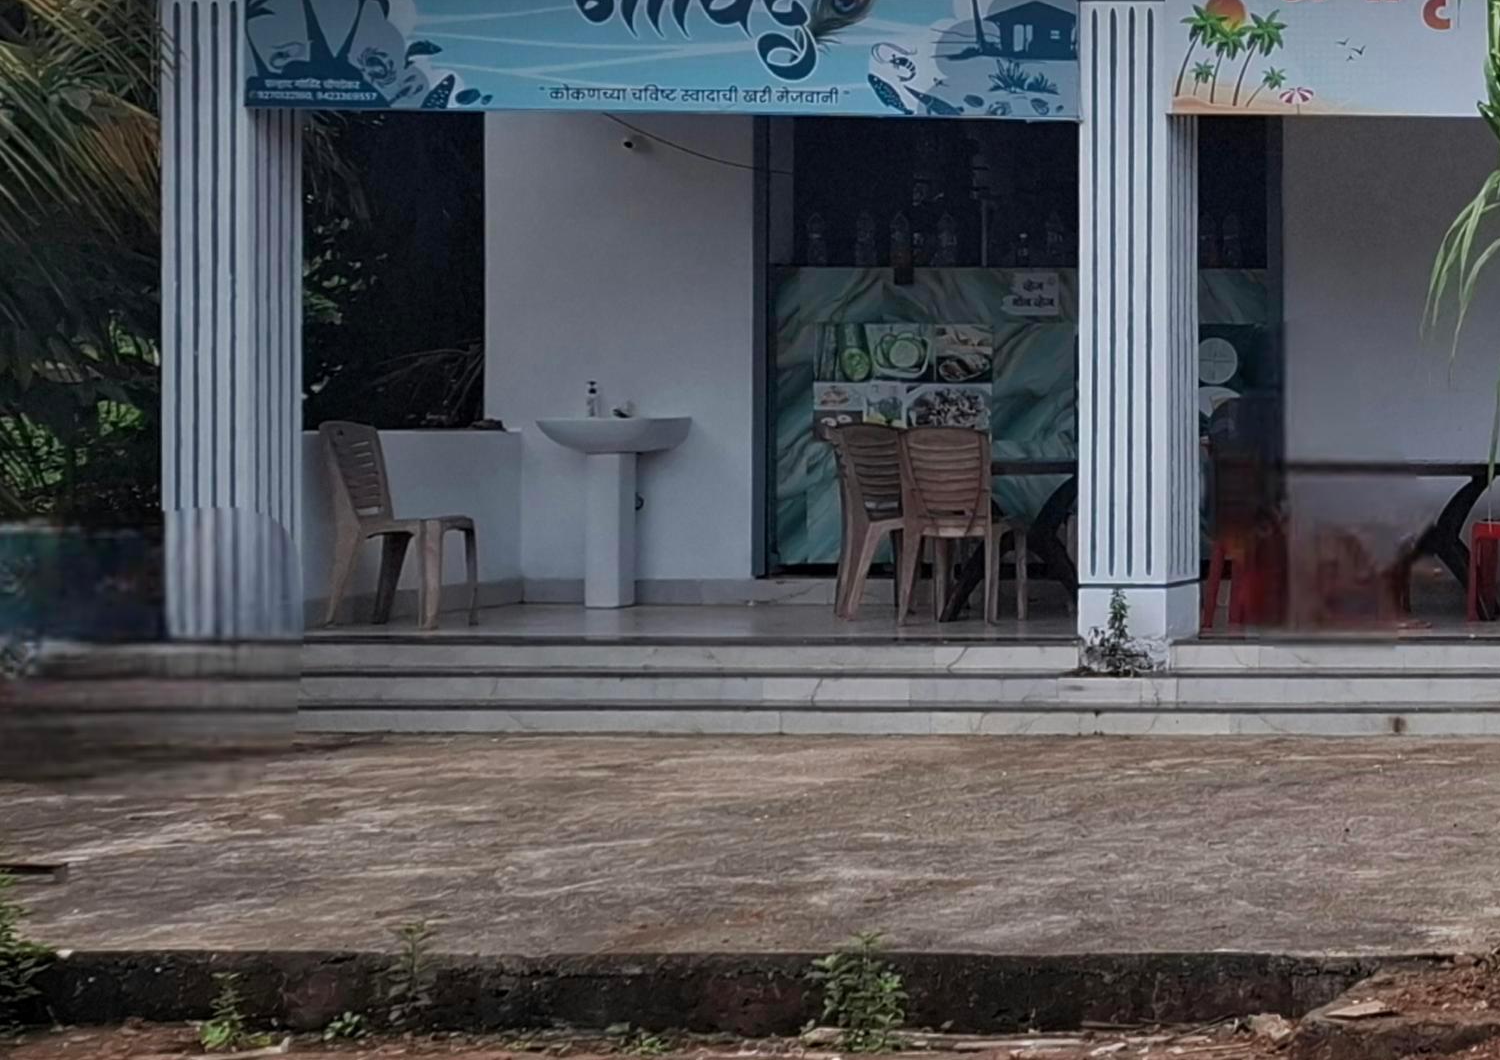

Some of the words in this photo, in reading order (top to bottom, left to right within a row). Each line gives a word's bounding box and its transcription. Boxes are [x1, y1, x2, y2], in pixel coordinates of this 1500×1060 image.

[549, 83, 627, 102] कोकणच्या
[632, 83, 678, 102] चविष्ट
[681, 84, 738, 103] स्वादाची
[743, 85, 772, 104] खरी
[776, 85, 839, 104] मेजवानी
